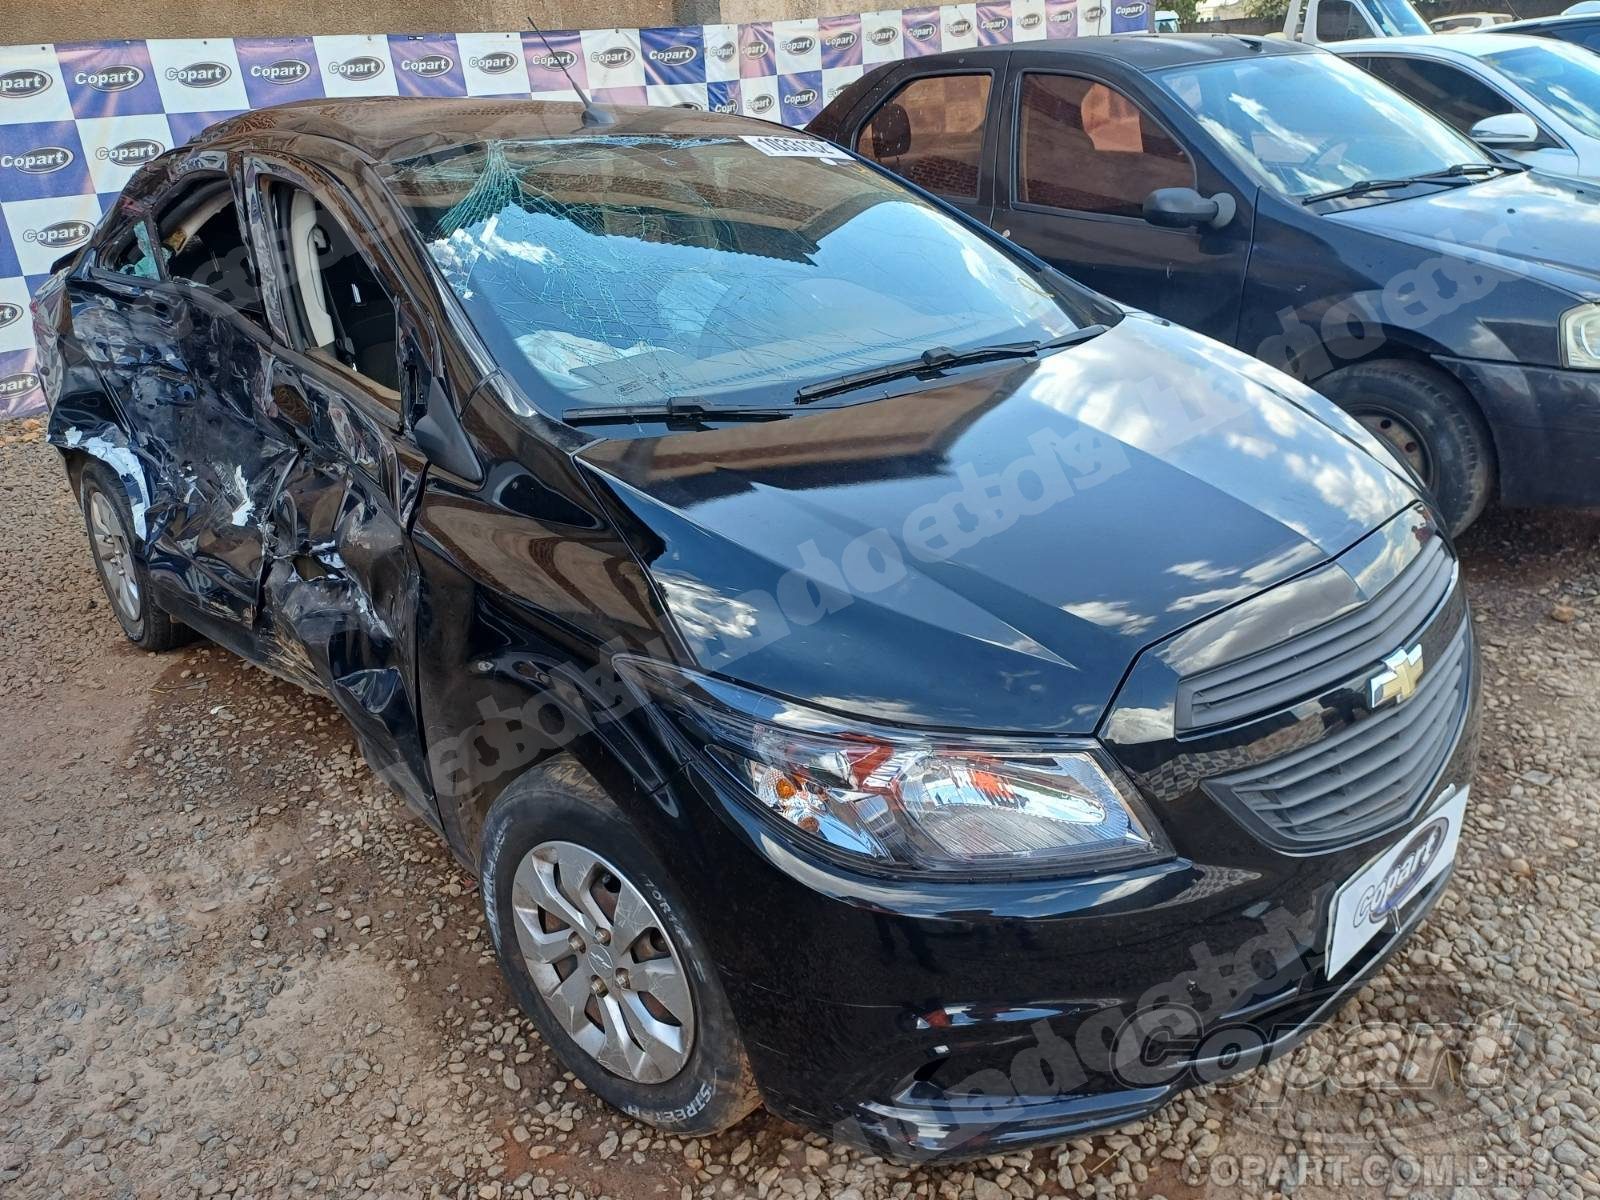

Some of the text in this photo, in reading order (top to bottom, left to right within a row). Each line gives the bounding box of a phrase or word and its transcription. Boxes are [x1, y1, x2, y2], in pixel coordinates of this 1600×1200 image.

[1115, 4, 1143, 15] Copart
[907, 26, 933, 37] Copart
[945, 21, 969, 33] Copart
[981, 20, 1005, 30] Copart
[826, 35, 853, 47] Copart
[866, 30, 894, 41] Copart
[780, 39, 810, 52] Copart
[532, 53, 572, 67] Copart
[591, 50, 629, 64] Copart
[650, 47, 692, 61] Copart
[250, 63, 306, 78] Copart
[328, 60, 378, 75] Copart
[401, 57, 447, 73] Copart
[469, 56, 512, 71] Copart
[75, 69, 135, 88] Copart
[166, 66, 222, 84] Copart
[0, 75, 41, 91] part
[784, 91, 813, 105] Copart
[1, 149, 63, 169] Copart
[96, 142, 155, 162] Copart
[23, 225, 86, 243] Copart
[1353, 829, 1438, 928] Copart
